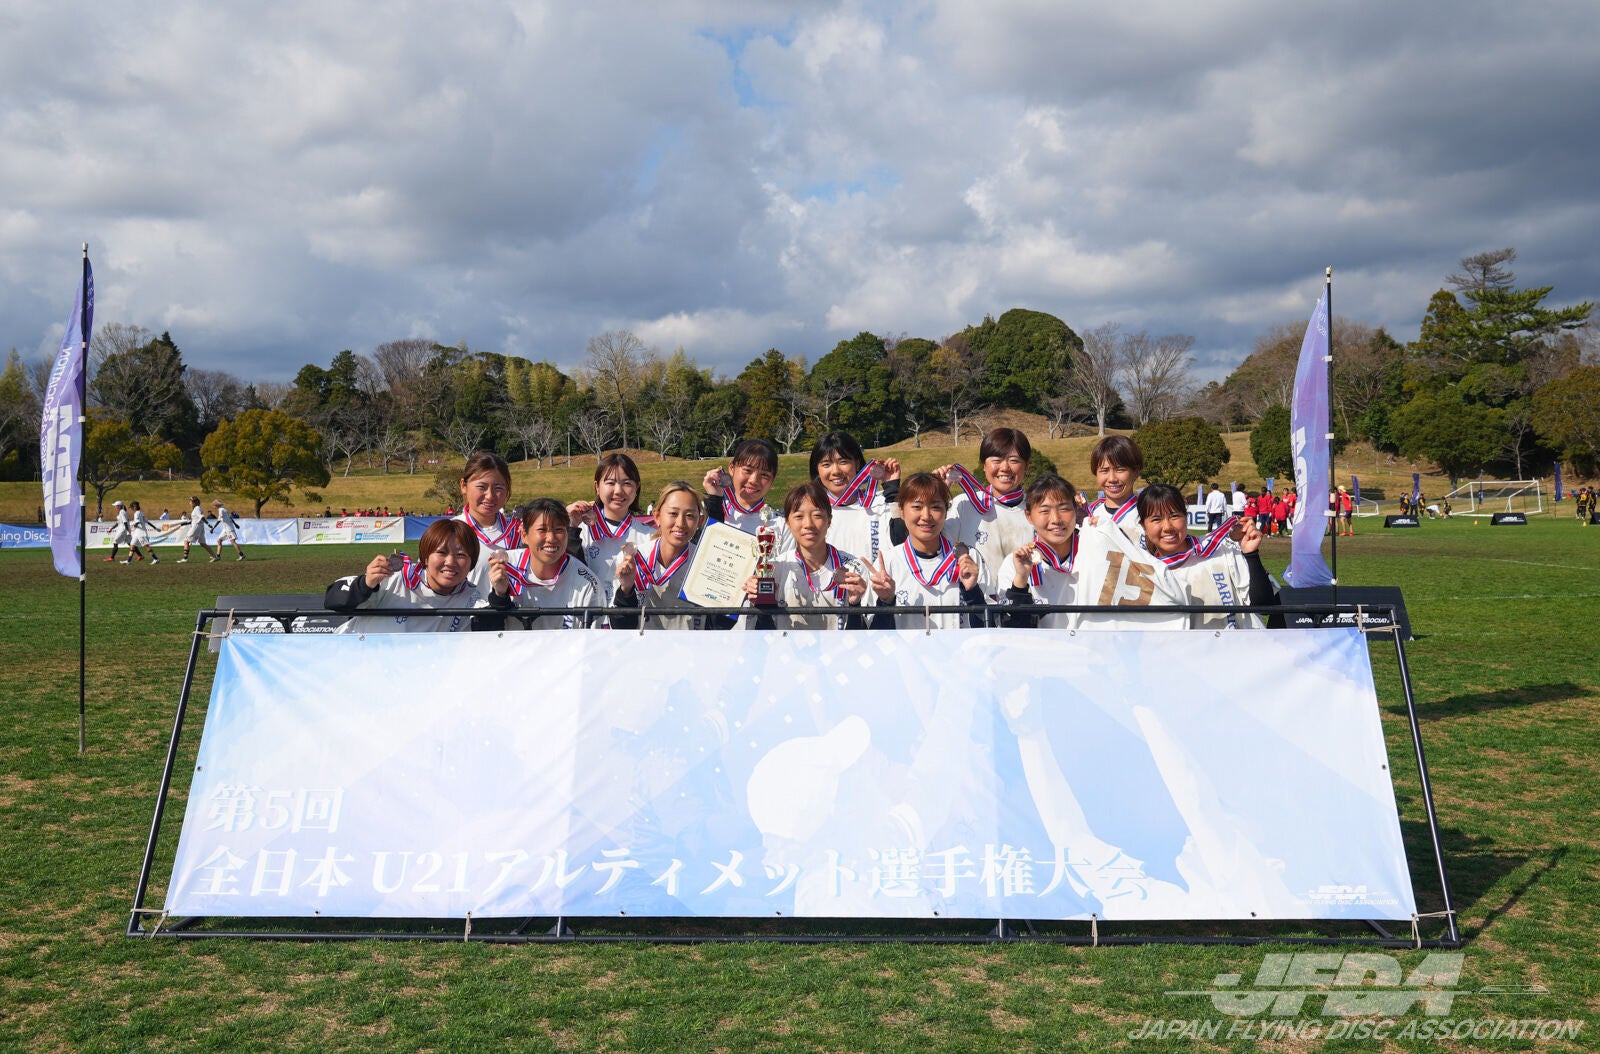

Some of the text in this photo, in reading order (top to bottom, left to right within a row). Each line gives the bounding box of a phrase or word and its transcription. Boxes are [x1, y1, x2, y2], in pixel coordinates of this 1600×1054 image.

[202, 784, 344, 834] 第5回
[190, 846, 355, 898] 全日本
